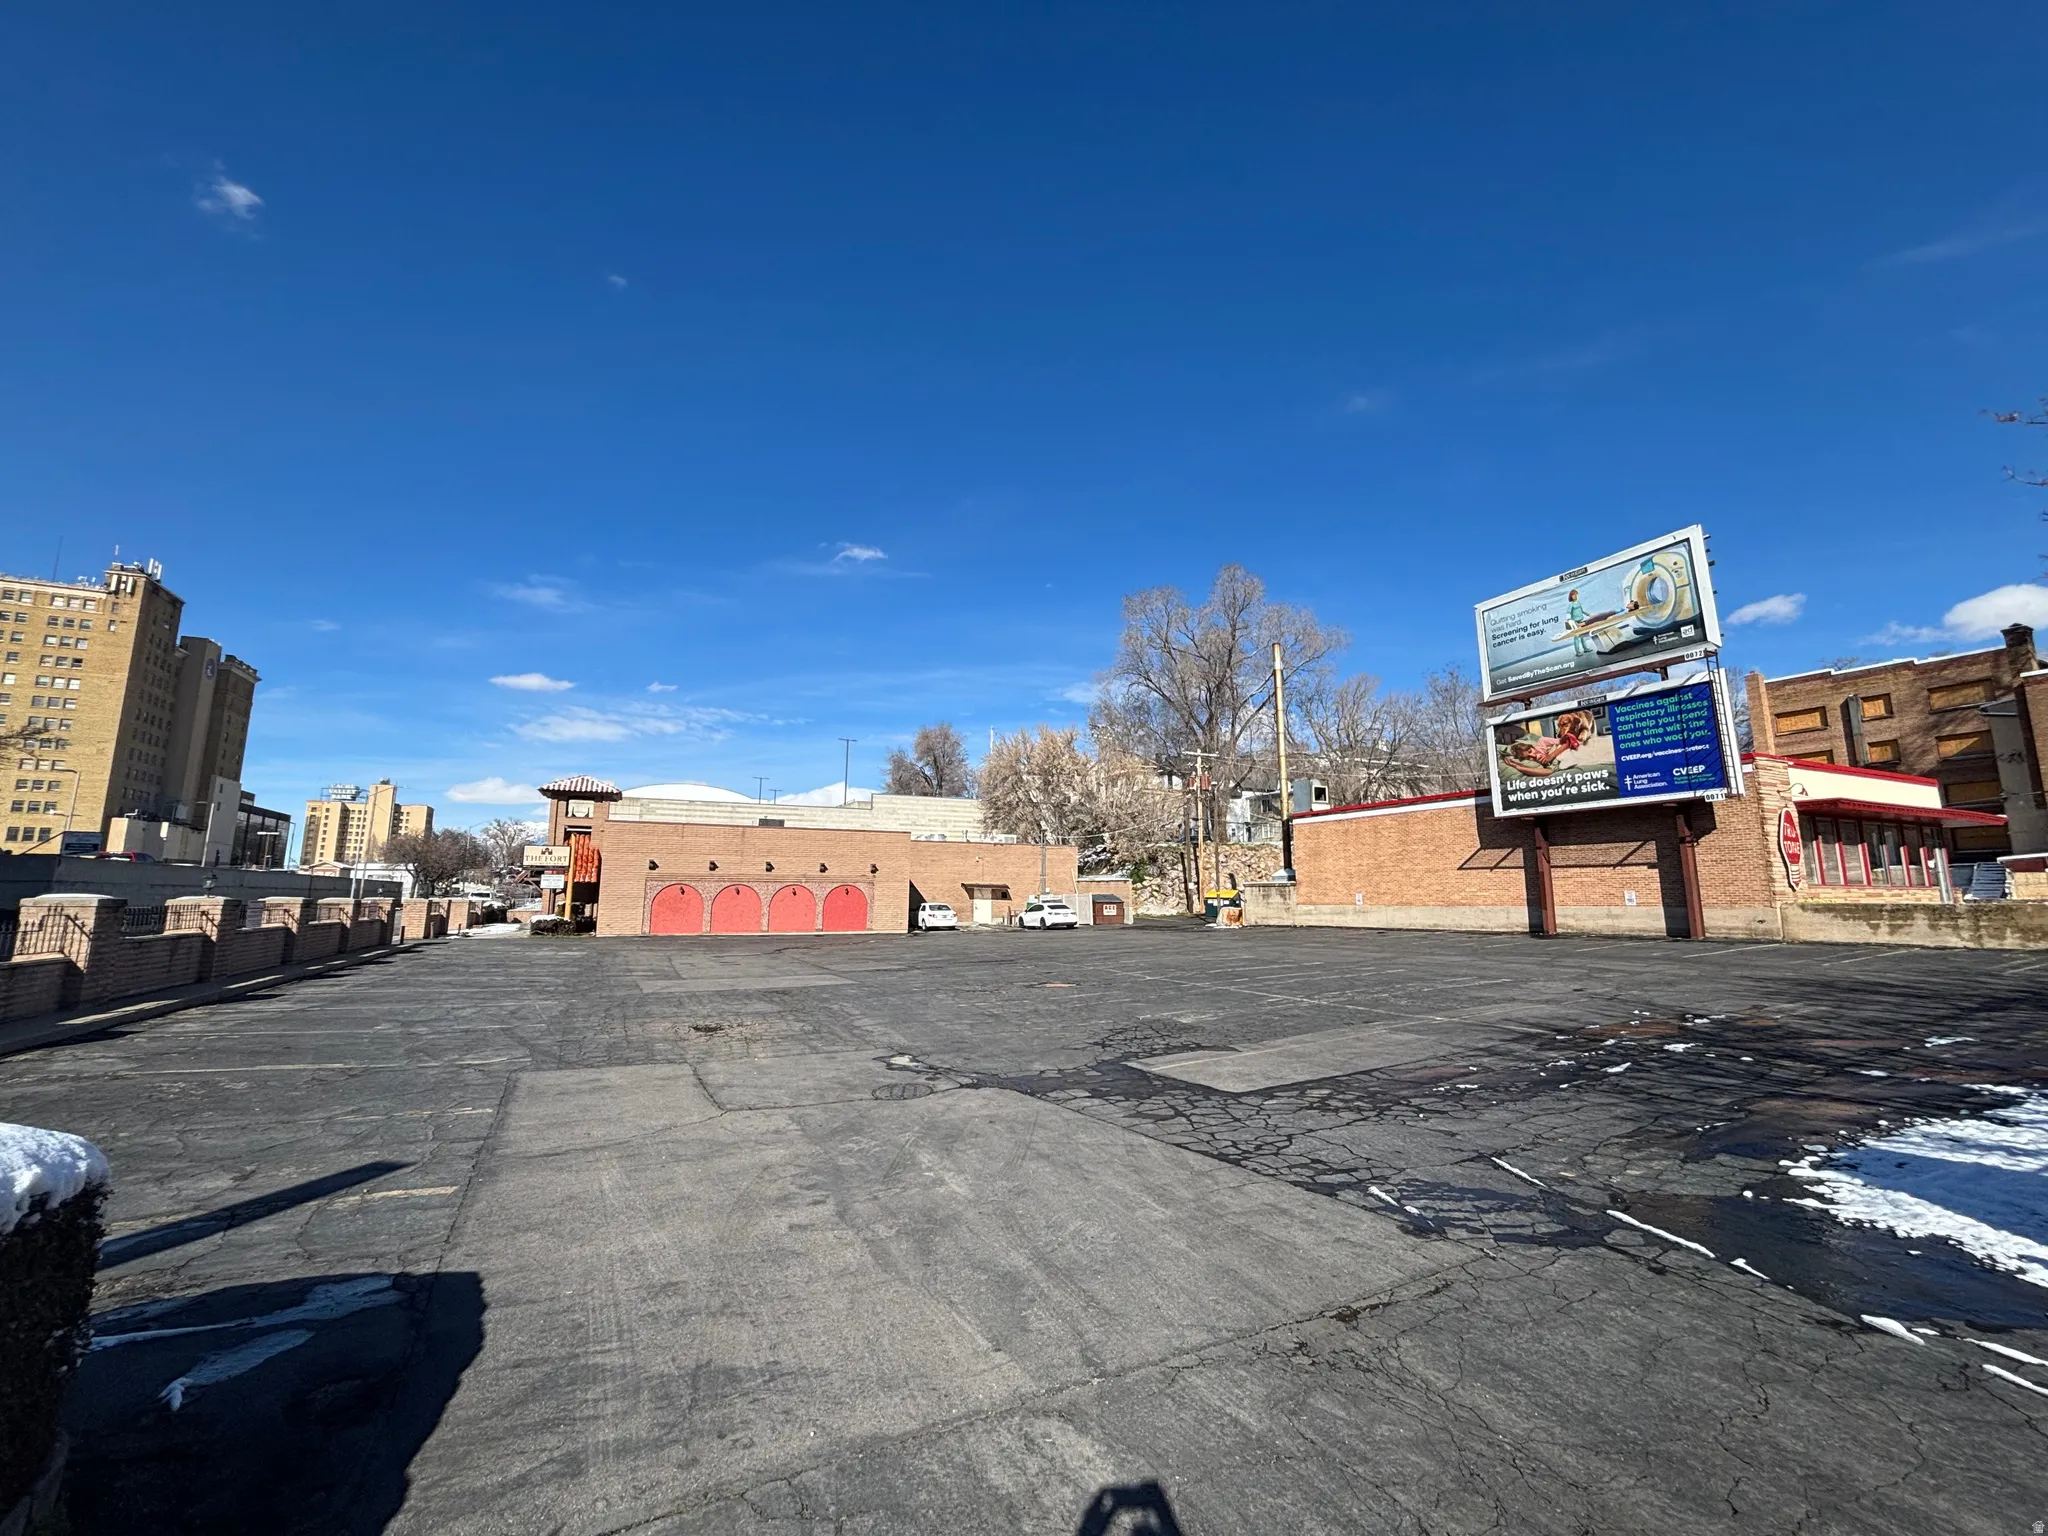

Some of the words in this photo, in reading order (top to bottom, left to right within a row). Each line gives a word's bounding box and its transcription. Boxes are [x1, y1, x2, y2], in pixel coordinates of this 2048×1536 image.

[1490, 614, 1516, 626] Quitting
[1517, 603, 1547, 617] smoking
[1491, 624, 1505, 634] was
[1492, 625, 1528, 641] Screening
[1529, 621, 1541, 630] for
[1542, 615, 1559, 627] lung
[1492, 635, 1518, 648] cancer
[1526, 628, 1547, 638] easy.
[1685, 650, 1703, 659] 0072
[1507, 660, 1575, 683] SavedByTheScan.org
[1614, 700, 1655, 714] Vaccines
[1616, 708, 1665, 723] respiratory
[1617, 723, 1634, 732] can
[1635, 718, 1656, 729] help
[1657, 715, 1675, 726] you
[1618, 732, 1642, 741] more
[1643, 727, 1664, 736] time
[1619, 740, 1641, 750] ones
[1642, 735, 1662, 746] who
[1632, 772, 1661, 780] American
[1672, 764, 1706, 776] CVEEP
[1506, 779, 1527, 791] Life
[1528, 772, 1573, 788] doesn't
[1574, 769, 1609, 784] paws
[1507, 791, 1539, 802] when
[1540, 785, 1579, 800] you're
[1580, 780, 1610, 793] sick.
[1705, 793, 1724, 801] 0071
[1783, 840, 1801, 855] TONE
